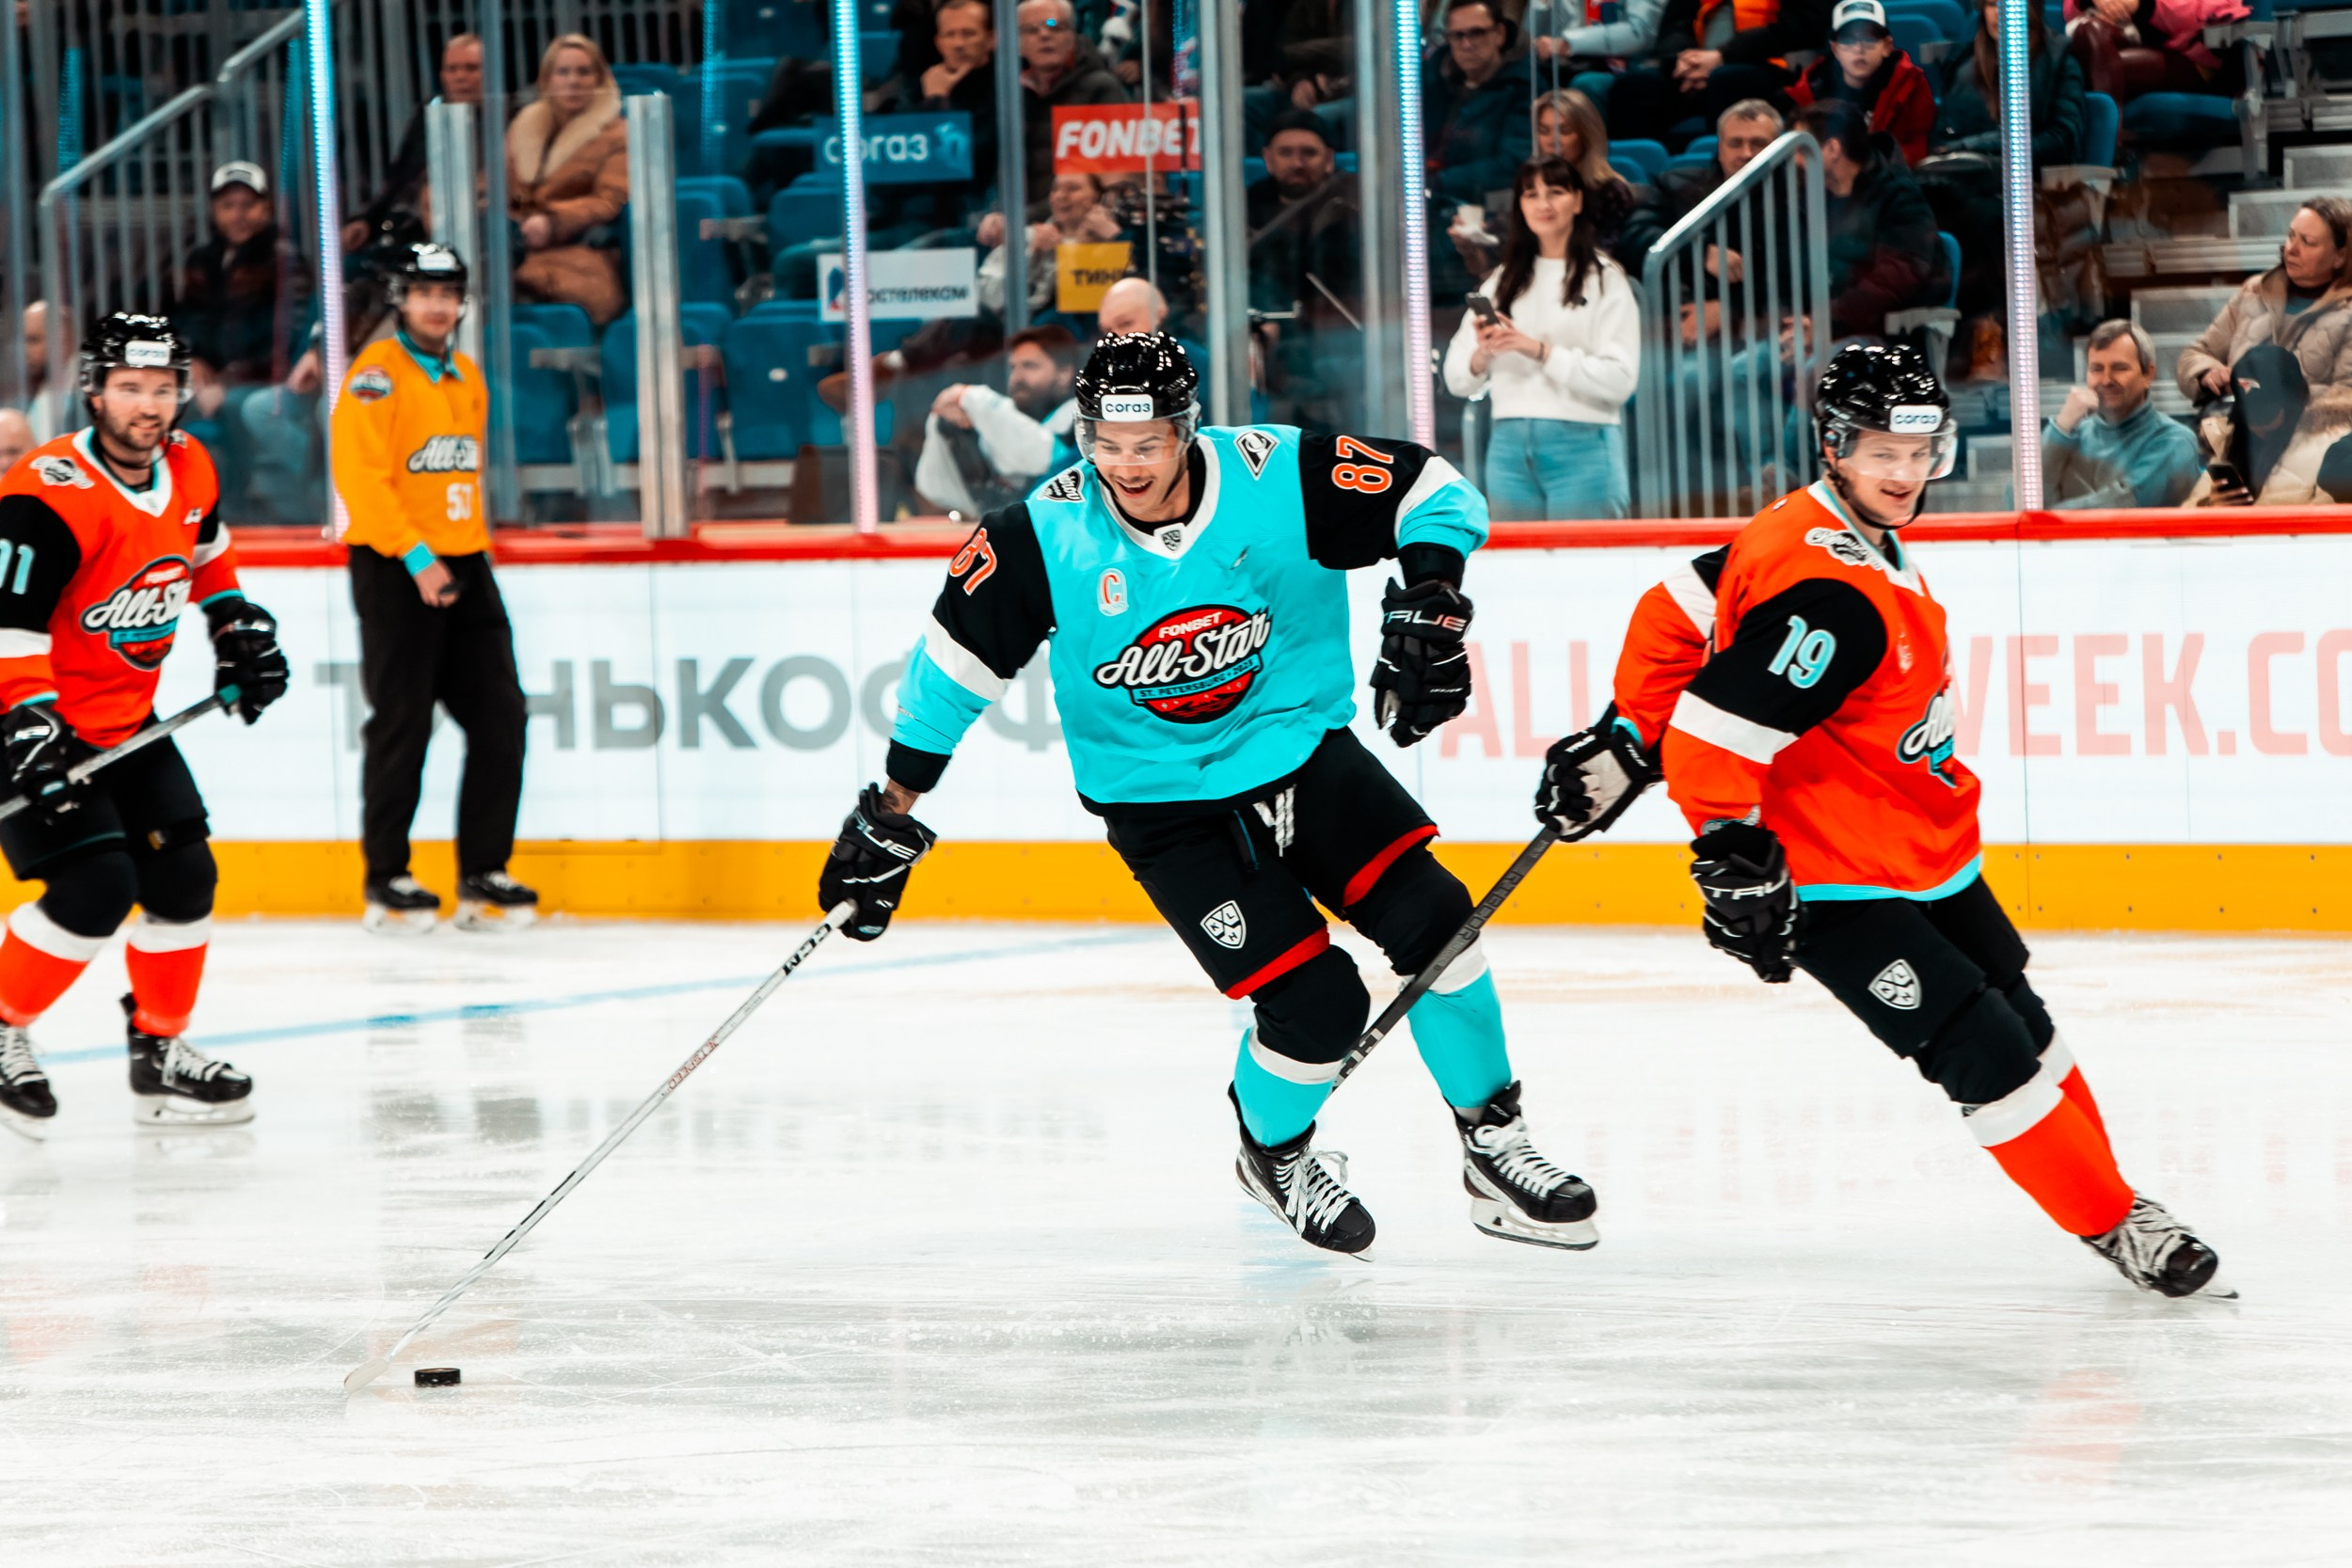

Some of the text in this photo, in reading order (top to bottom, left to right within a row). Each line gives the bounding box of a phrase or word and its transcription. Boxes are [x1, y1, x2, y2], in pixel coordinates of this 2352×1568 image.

[1056, 119, 1200, 158] FONBET
[1104, 402, 1151, 414] согаз
[1332, 436, 1393, 493] 87
[949, 528, 997, 595] 87
[1096, 612, 1271, 687] All-Star
[1158, 611, 1223, 639] FONBET
[1768, 615, 1837, 689] 19
[783, 923, 833, 975] CCM
